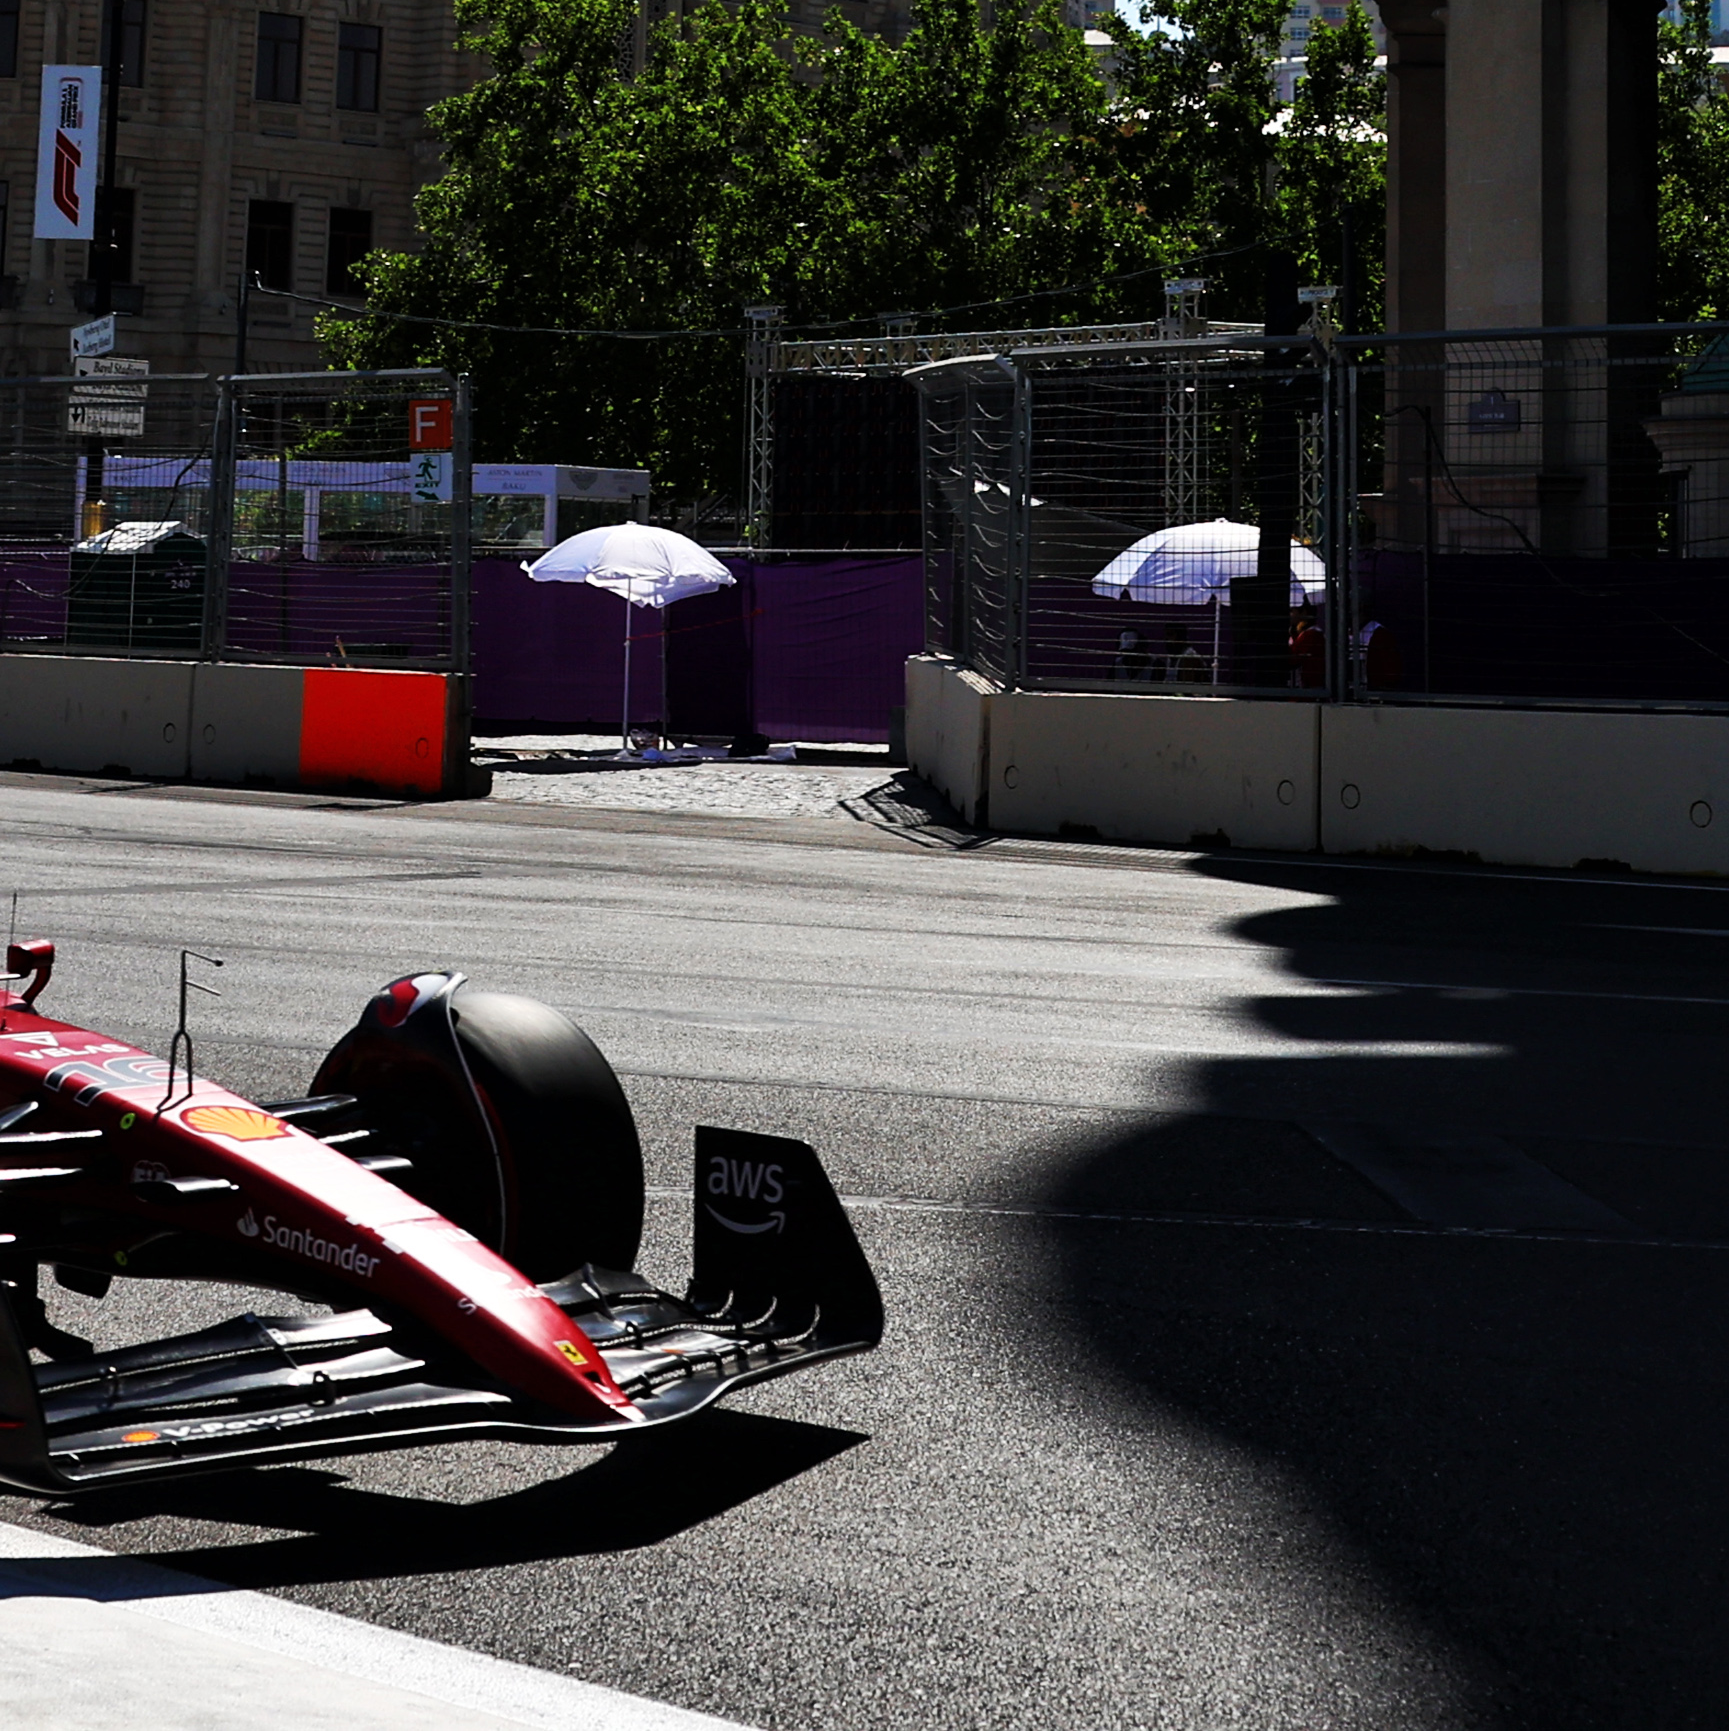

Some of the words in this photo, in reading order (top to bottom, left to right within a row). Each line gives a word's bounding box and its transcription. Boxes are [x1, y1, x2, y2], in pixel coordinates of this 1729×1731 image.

[415, 406, 439, 443] F
[14, 1042, 131, 1060] VELAS
[42, 1055, 197, 1107] 16
[708, 1156, 784, 1203] aws
[261, 1214, 381, 1279] Santander
[161, 1408, 315, 1438] V-Power
